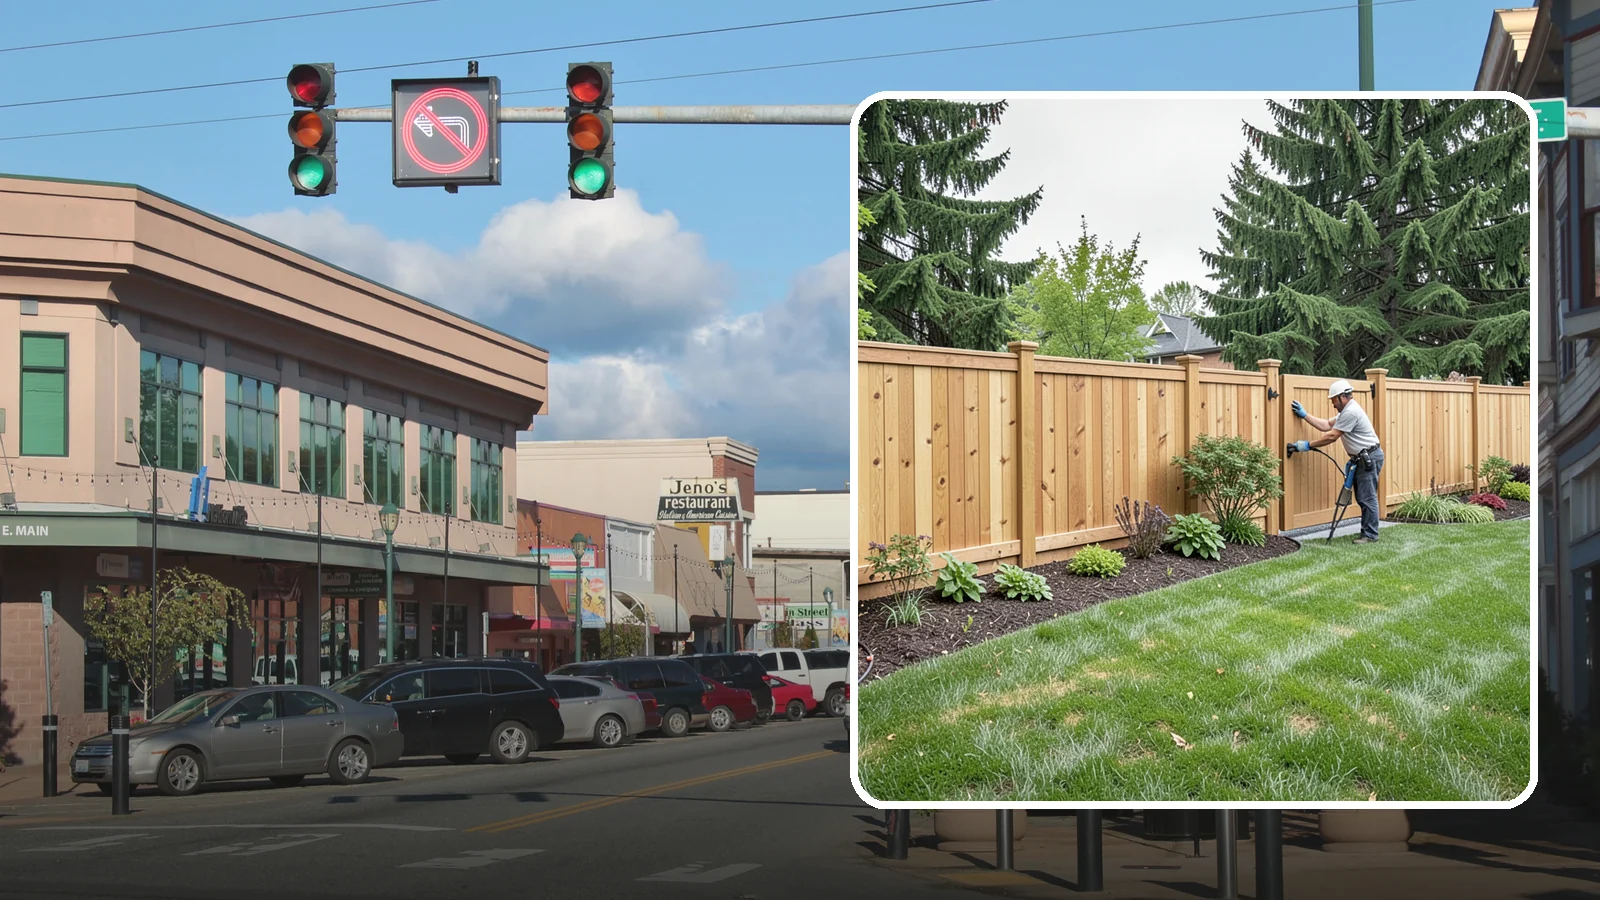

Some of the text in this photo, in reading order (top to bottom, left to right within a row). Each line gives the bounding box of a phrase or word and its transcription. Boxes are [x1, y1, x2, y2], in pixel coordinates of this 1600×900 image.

[669, 480, 728, 494] Jeno's
[665, 496, 731, 509] restaurant
[658, 509, 682, 520] Italian
[685, 509, 715, 520] American
[714, 509, 738, 520] Cuisine
[2, 525, 49, 536] E. MAIN
[786, 607, 795, 616] in
[797, 607, 828, 616] Street
[791, 619, 823, 627] lass
